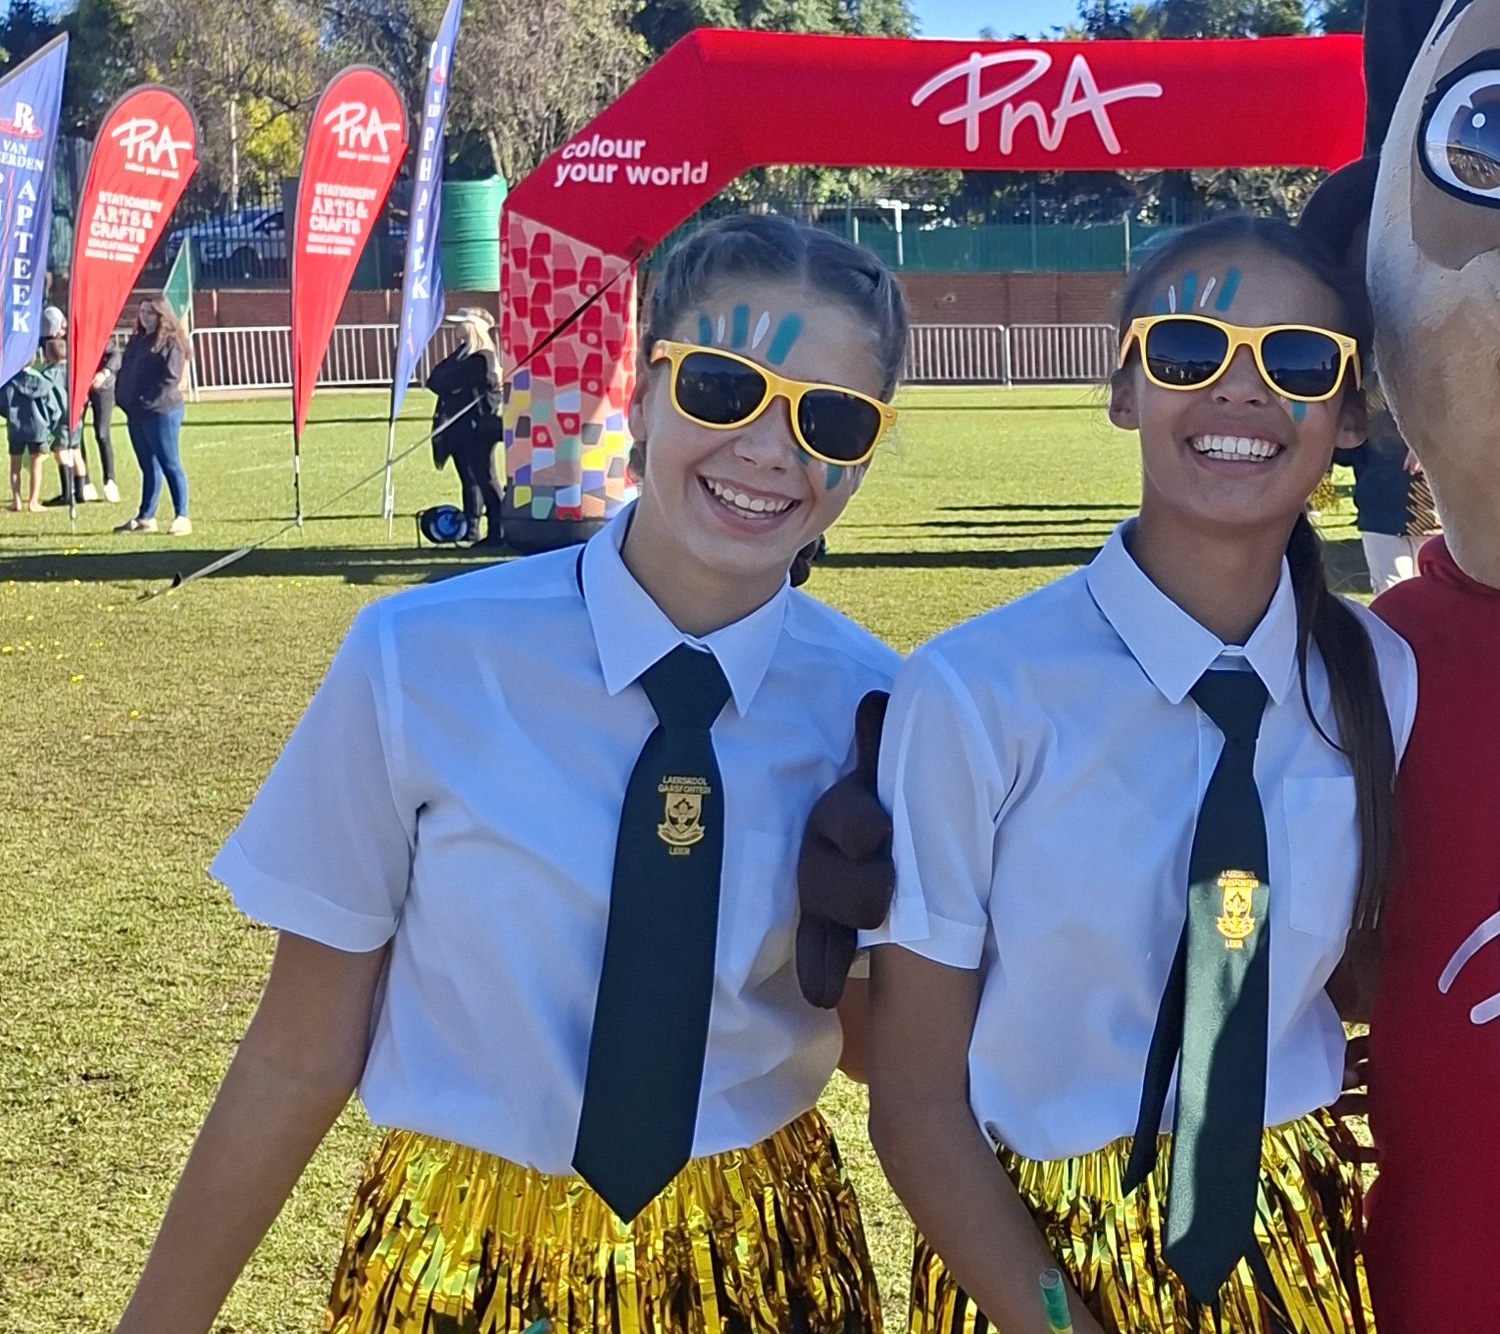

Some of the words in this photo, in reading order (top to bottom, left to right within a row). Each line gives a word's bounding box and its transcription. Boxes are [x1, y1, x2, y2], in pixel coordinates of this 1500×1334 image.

[911, 49, 1163, 155] PnA
[111, 117, 192, 169] PnA
[323, 101, 400, 153] PnA
[562, 134, 646, 159] colour
[0, 152, 44, 172] ERDEN
[3, 139, 28, 156] VAN
[554, 163, 619, 187] your
[626, 161, 708, 186] world
[12, 179, 37, 334] APTEEK
